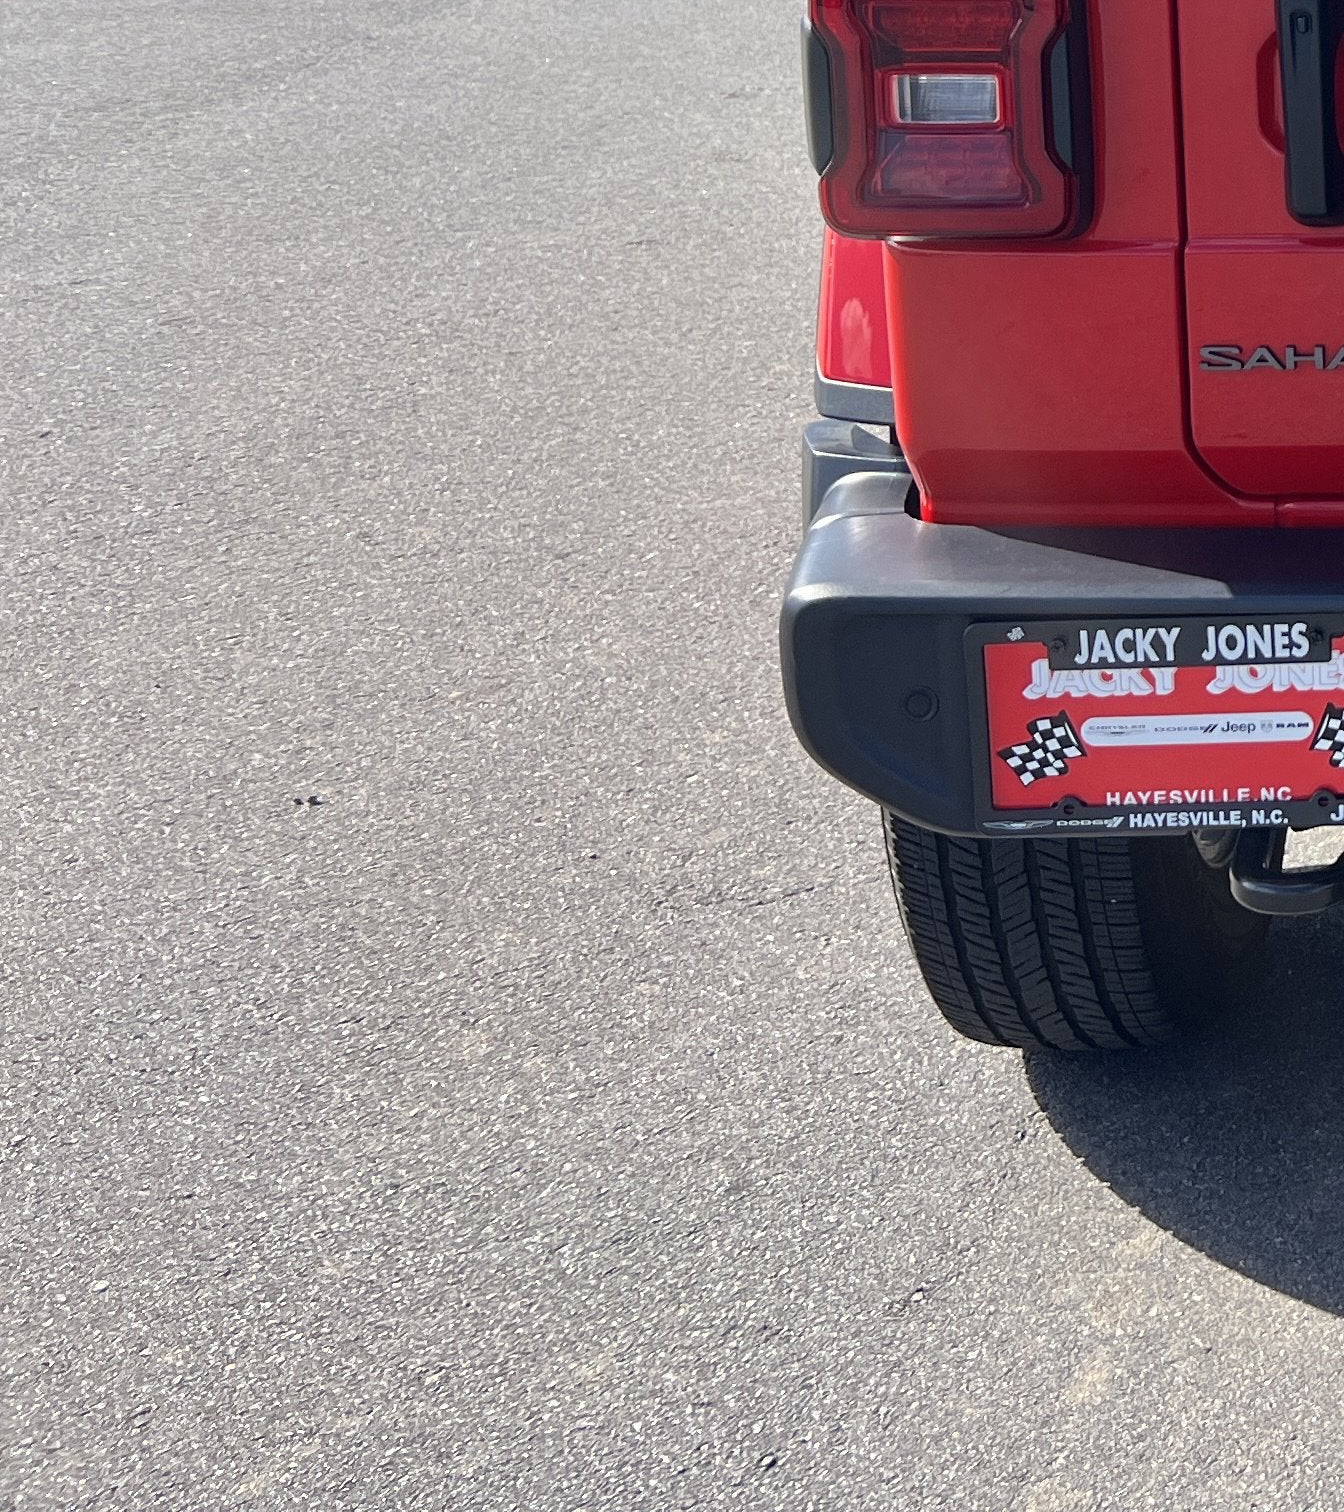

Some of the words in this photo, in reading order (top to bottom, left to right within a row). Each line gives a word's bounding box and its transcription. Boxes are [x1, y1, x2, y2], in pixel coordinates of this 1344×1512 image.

[1073, 626, 1181, 665] JACKY
[1201, 622, 1310, 661] JONES
[1022, 659, 1178, 700] JACKY
[1221, 720, 1256, 734] Jeep
[1275, 721, 1310, 729] RAM
[1129, 809, 1247, 828] HAYESVILLE,
[1251, 809, 1289, 825] N.C.
